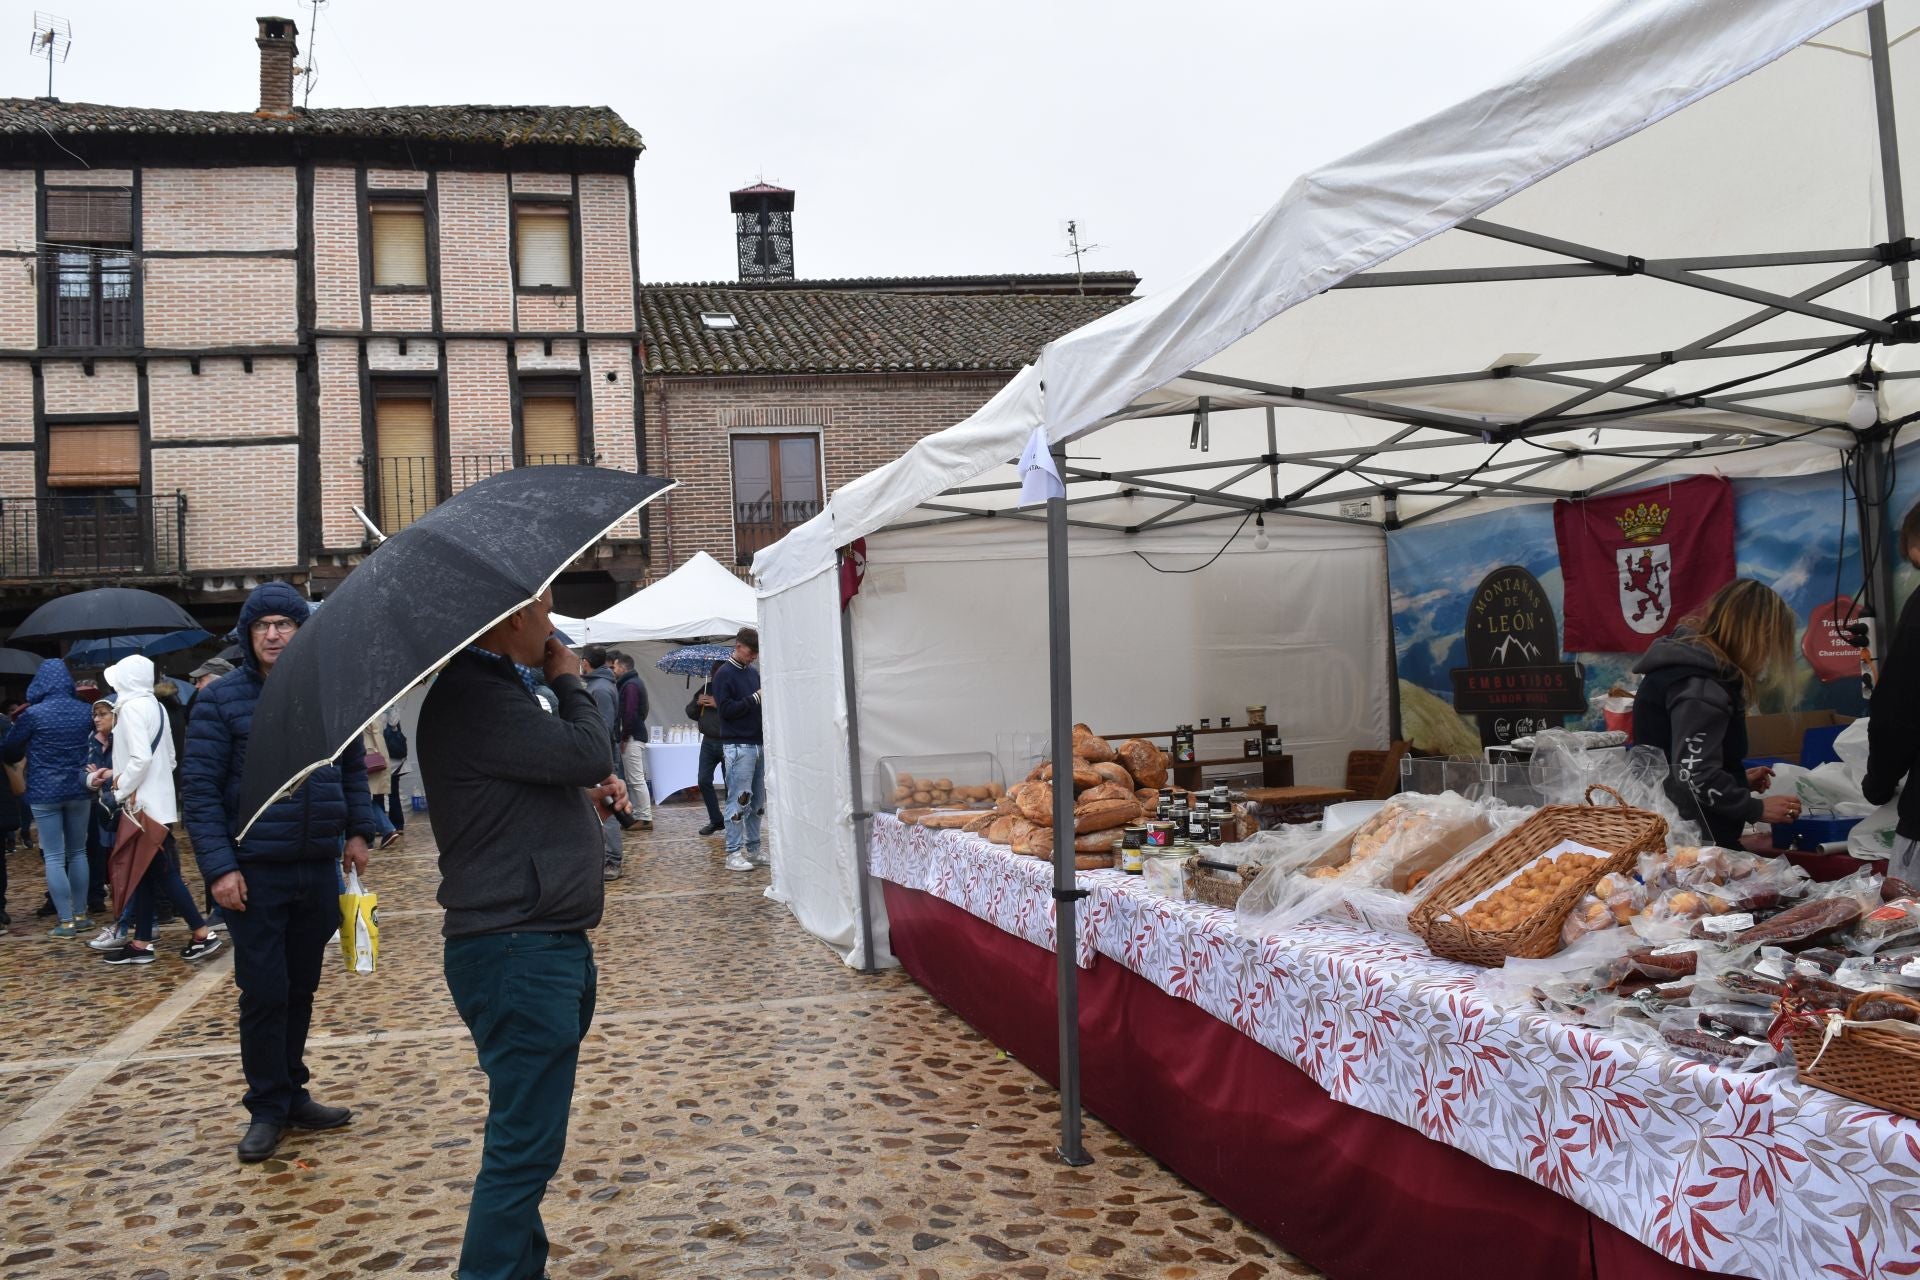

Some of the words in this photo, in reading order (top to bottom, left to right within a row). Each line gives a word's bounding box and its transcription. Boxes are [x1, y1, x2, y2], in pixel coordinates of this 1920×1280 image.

[1476, 578, 1540, 614] MONTAÑAS
[1505, 596, 1519, 607] DE
[1488, 609, 1535, 633] LEÓN
[1469, 674, 1563, 689] EMBUTIDOS
